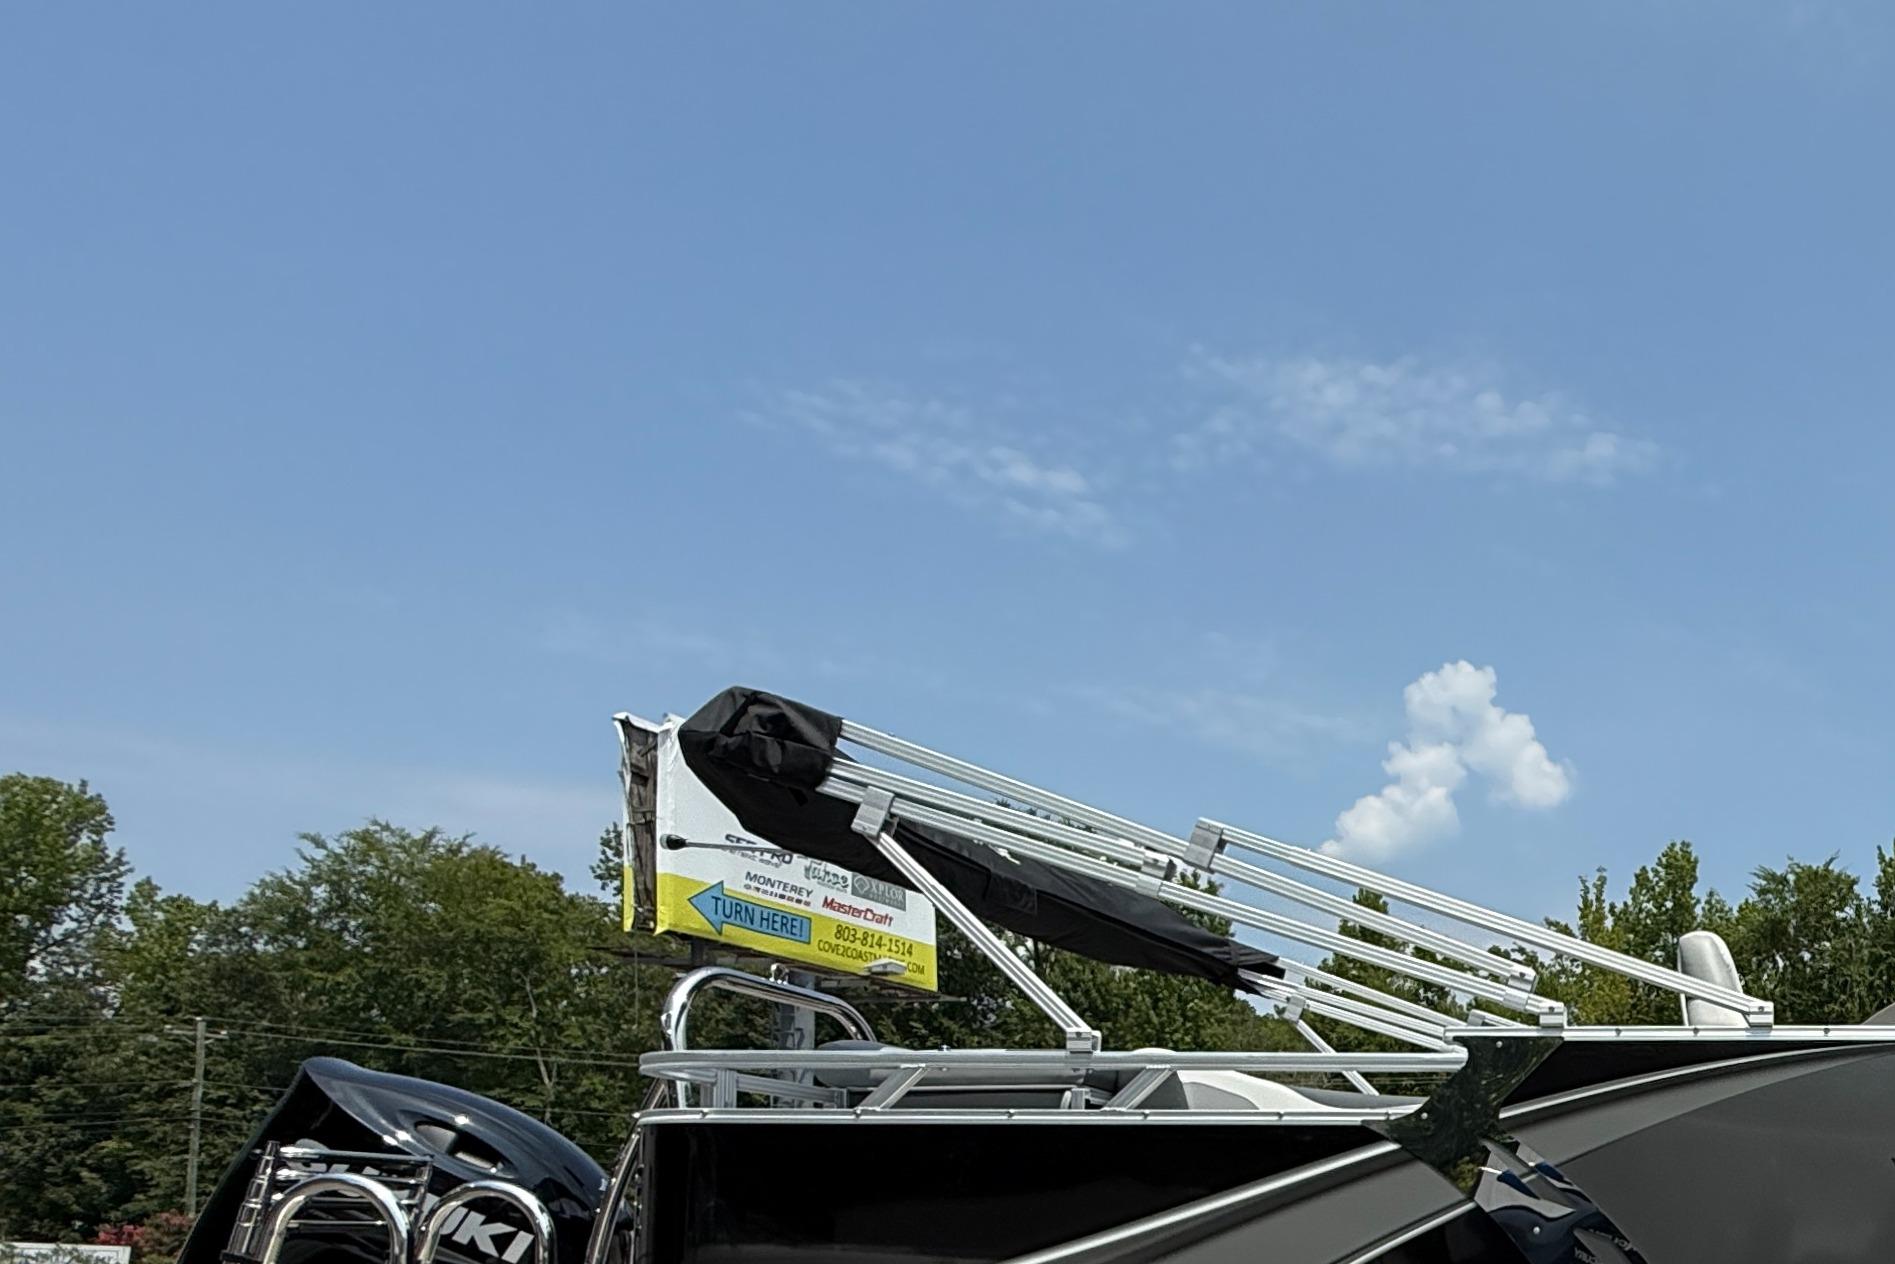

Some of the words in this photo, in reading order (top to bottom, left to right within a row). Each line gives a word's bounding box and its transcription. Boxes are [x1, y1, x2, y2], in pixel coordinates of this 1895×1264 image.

[745, 871, 814, 898] MONTEREY
[711, 895, 755, 926] TURN
[760, 909, 804, 938] HERE!
[822, 896, 894, 927] MasterCraft
[834, 924, 913, 957] 803-814-1514
